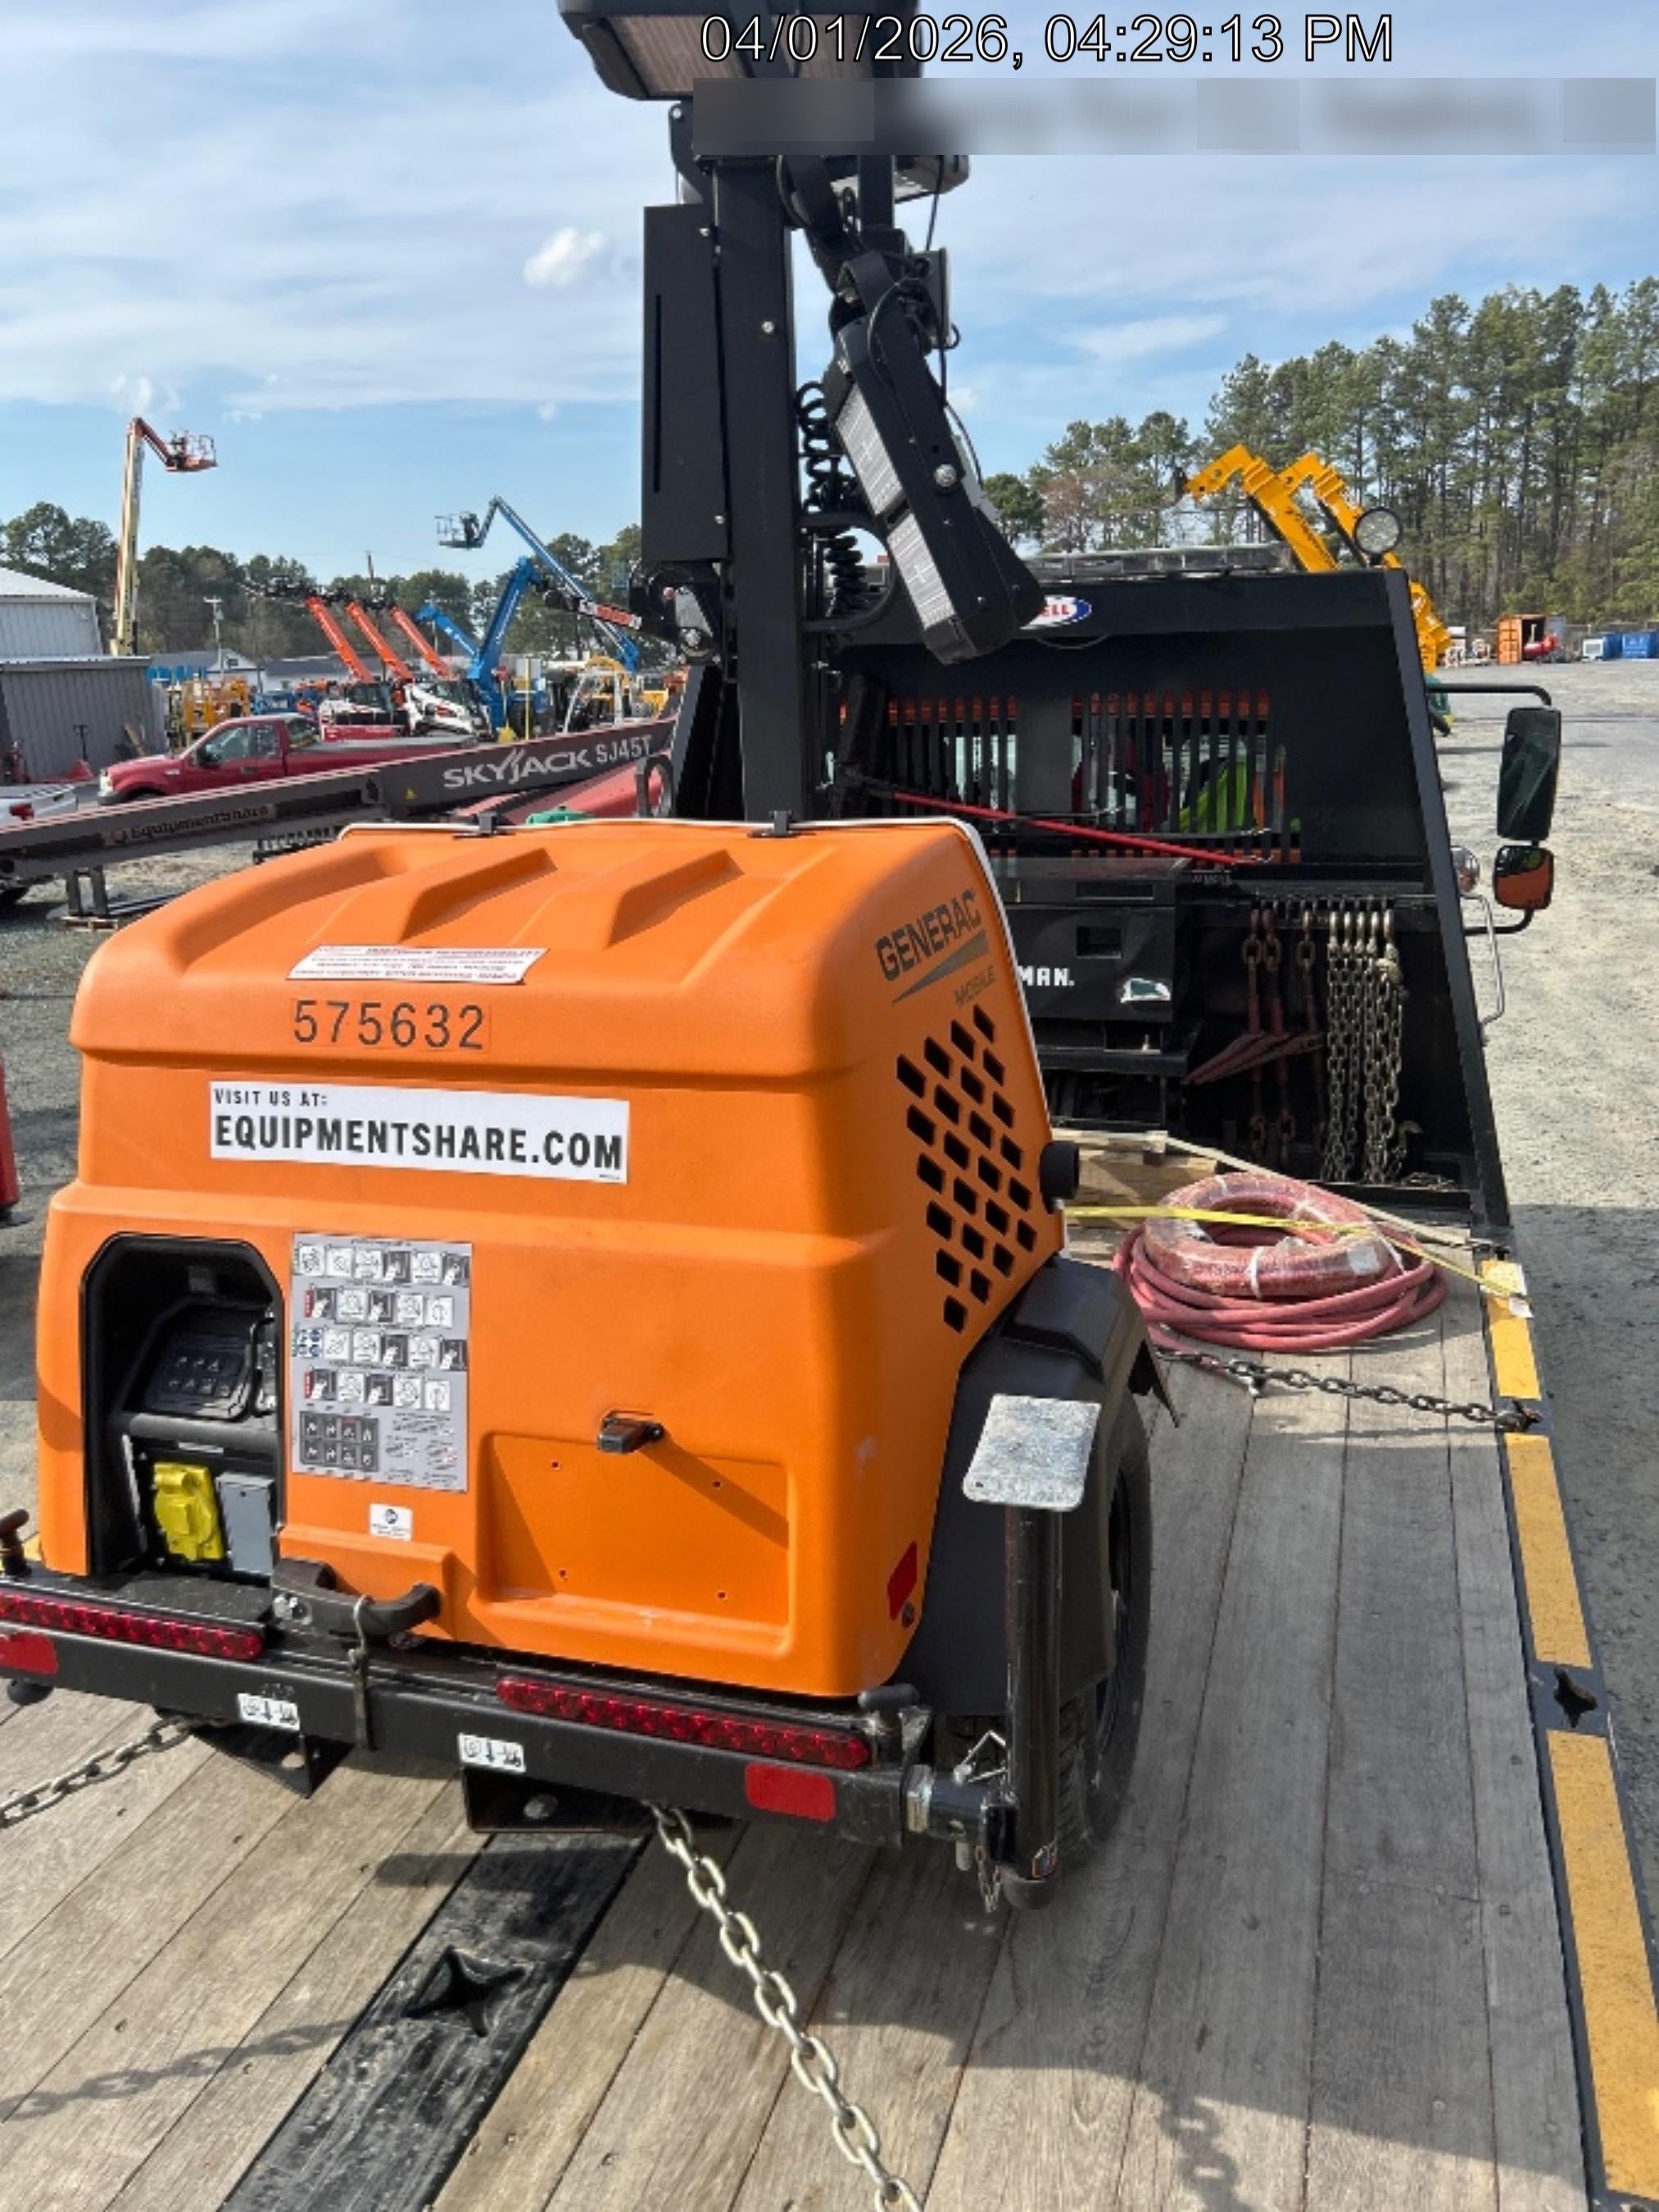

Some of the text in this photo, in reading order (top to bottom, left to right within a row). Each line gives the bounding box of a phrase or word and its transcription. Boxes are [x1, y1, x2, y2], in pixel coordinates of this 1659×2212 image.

[442, 735, 653, 789] SKYJACK SJ45T
[874, 888, 981, 981] GENERAC
[293, 999, 483, 1050] 575632
[213, 1087, 328, 1108] VISIT US AT:
[214, 1113, 623, 1171] EQUIPMENTSHARE.COM
